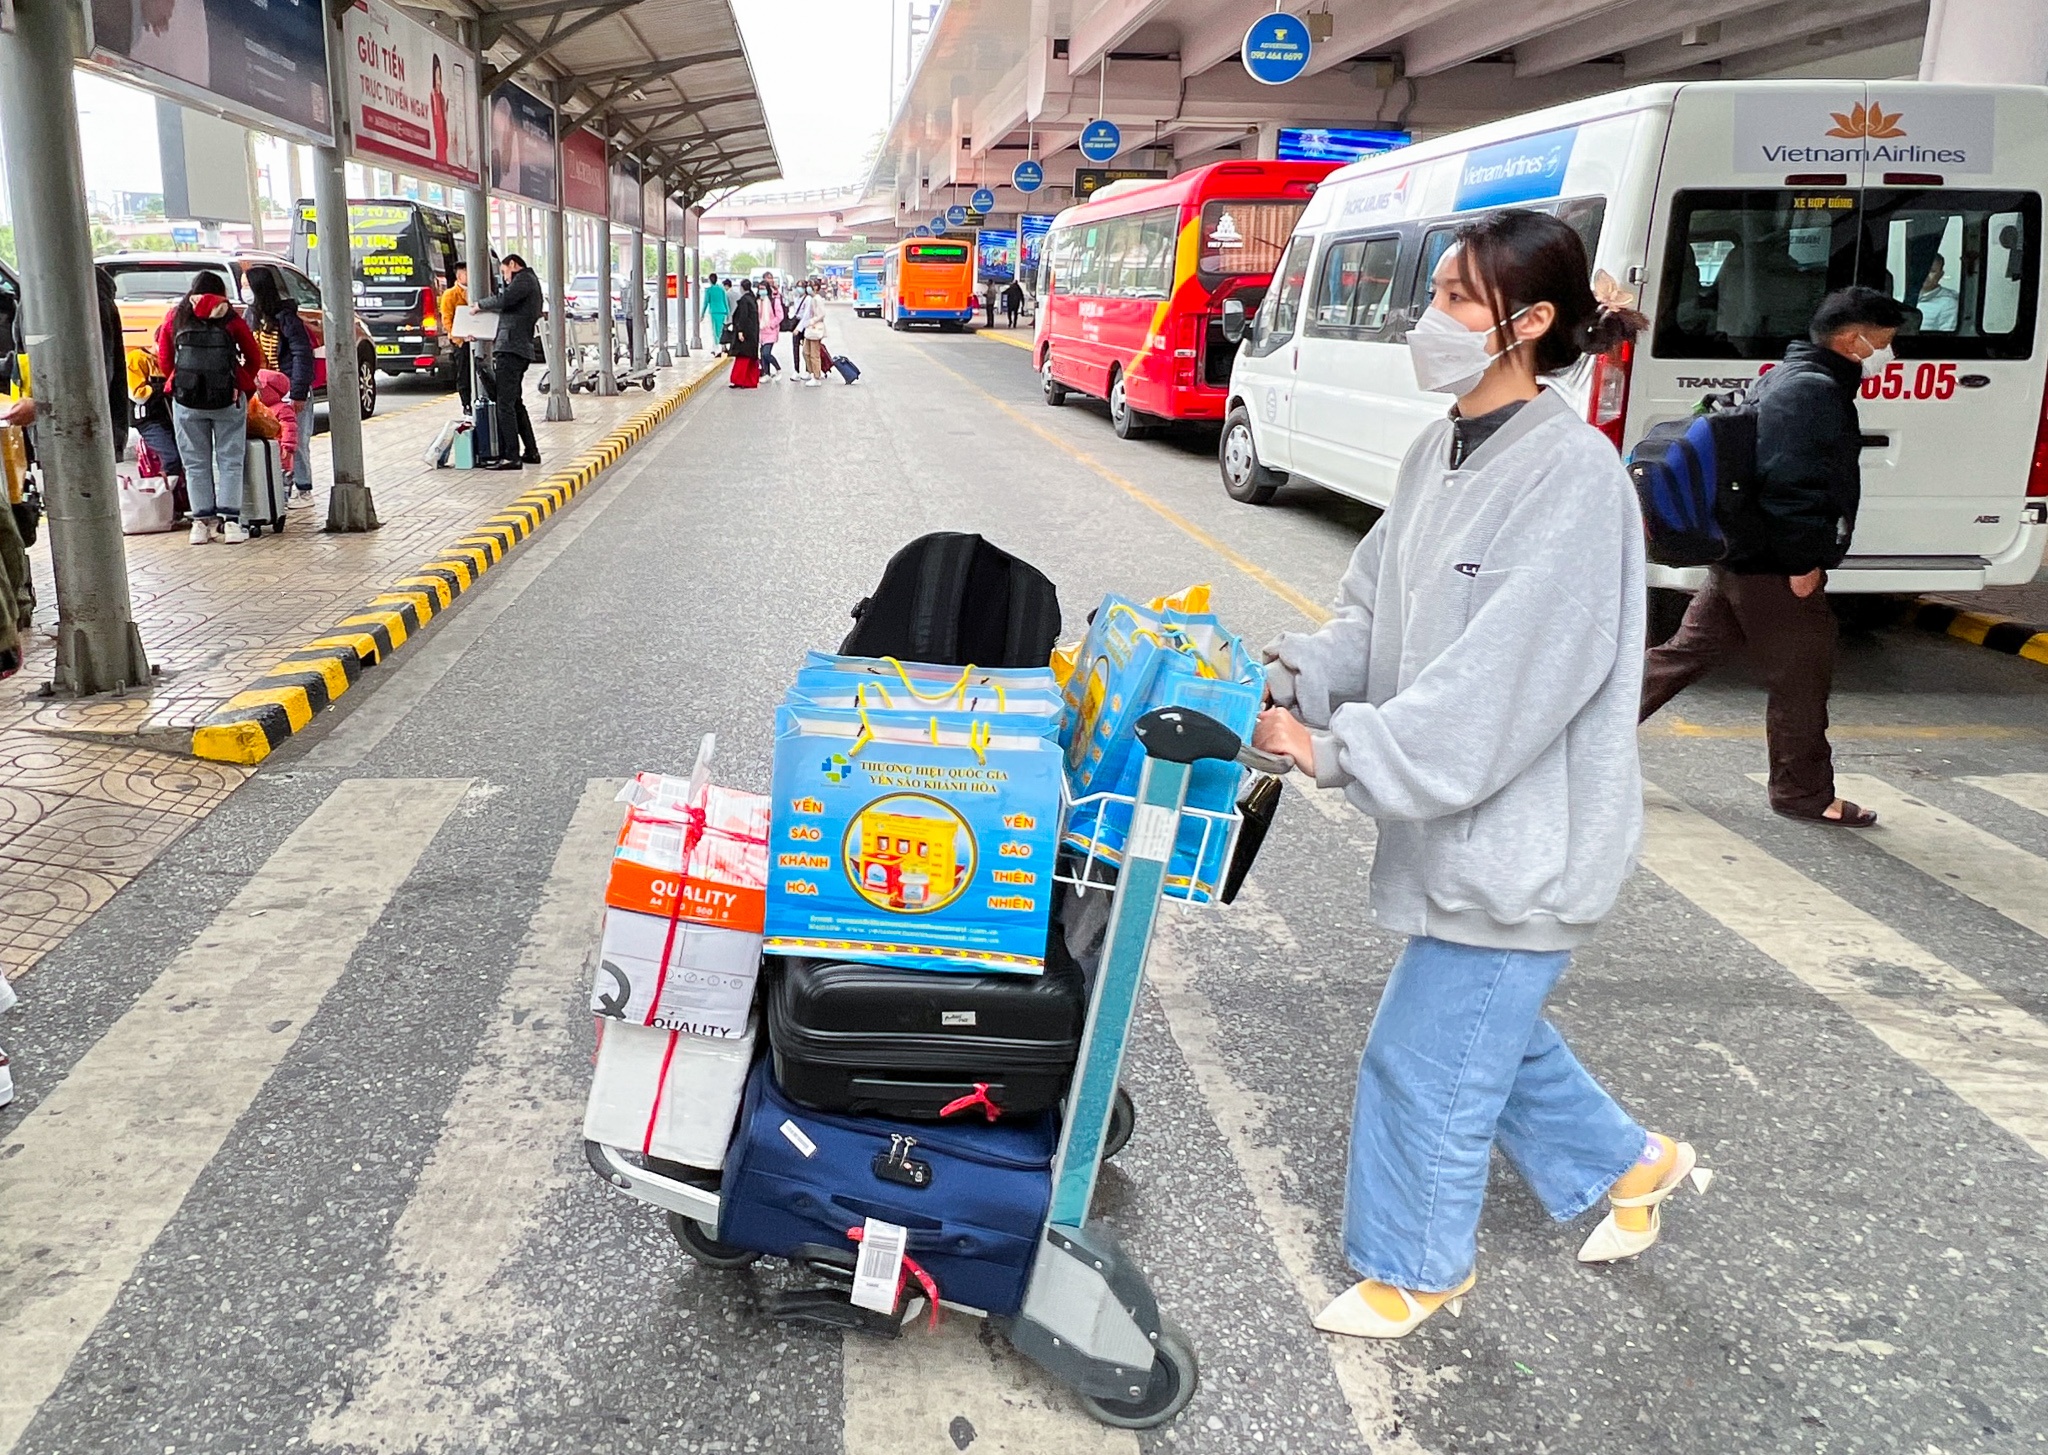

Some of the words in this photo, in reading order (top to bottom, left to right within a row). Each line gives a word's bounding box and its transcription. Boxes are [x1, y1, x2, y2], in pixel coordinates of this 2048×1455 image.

[1251, 51, 1266, 60] 090
[1266, 51, 1282, 60] 464
[1283, 52, 1304, 61] 6699
[1762, 145, 1869, 163] Vietnam
[1873, 144, 1966, 163] Airlines
[1463, 163, 1505, 186] Vietnam
[1503, 155, 1544, 178] Airlines
[1793, 197, 1806, 208] XE
[363, 256, 413, 265] HOTLINE:
[1676, 377, 1753, 389] TRANSIT
[1973, 515, 2000, 524] ABS
[861, 761, 912, 775] THƯƠNG
[915, 766, 945, 779] HIỆU
[948, 767, 983, 780] QUỐC
[986, 769, 1008, 781] GIA
[869, 773, 893, 786] YẾN
[924, 779, 967, 792] KHÁNH
[793, 796, 823, 814] YẾN
[1003, 812, 1034, 830] YẾN
[779, 853, 829, 869] KHÁNH
[992, 869, 1035, 885] THIÊN
[651, 879, 737, 908] QUALITY
[786, 878, 818, 895] HÒA
[650, 897, 663, 906] A4
[987, 895, 1034, 911] NHIÊN
[652, 1017, 731, 1039] QUALITY
